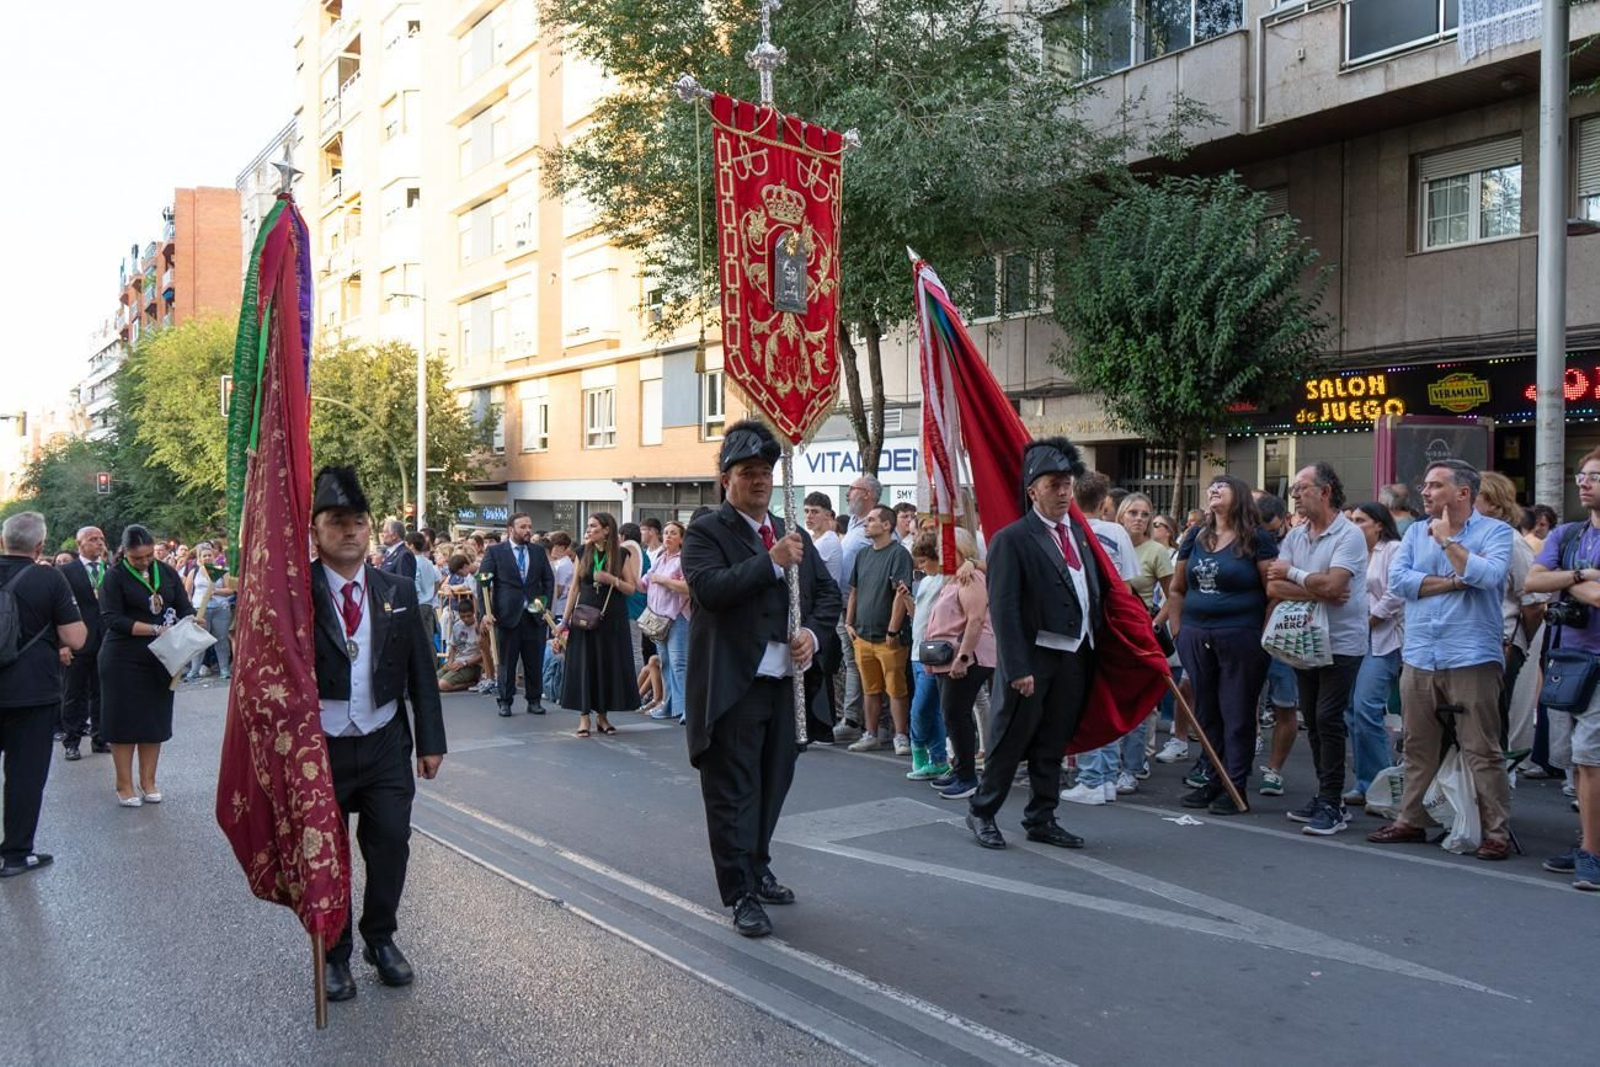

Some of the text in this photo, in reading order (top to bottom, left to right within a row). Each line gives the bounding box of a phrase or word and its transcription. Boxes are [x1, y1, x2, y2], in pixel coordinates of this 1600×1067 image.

[1306, 375, 1386, 399] SALON
[1433, 386, 1485, 399] VERAMATIC
[1296, 397, 1405, 423] de JUEGO
